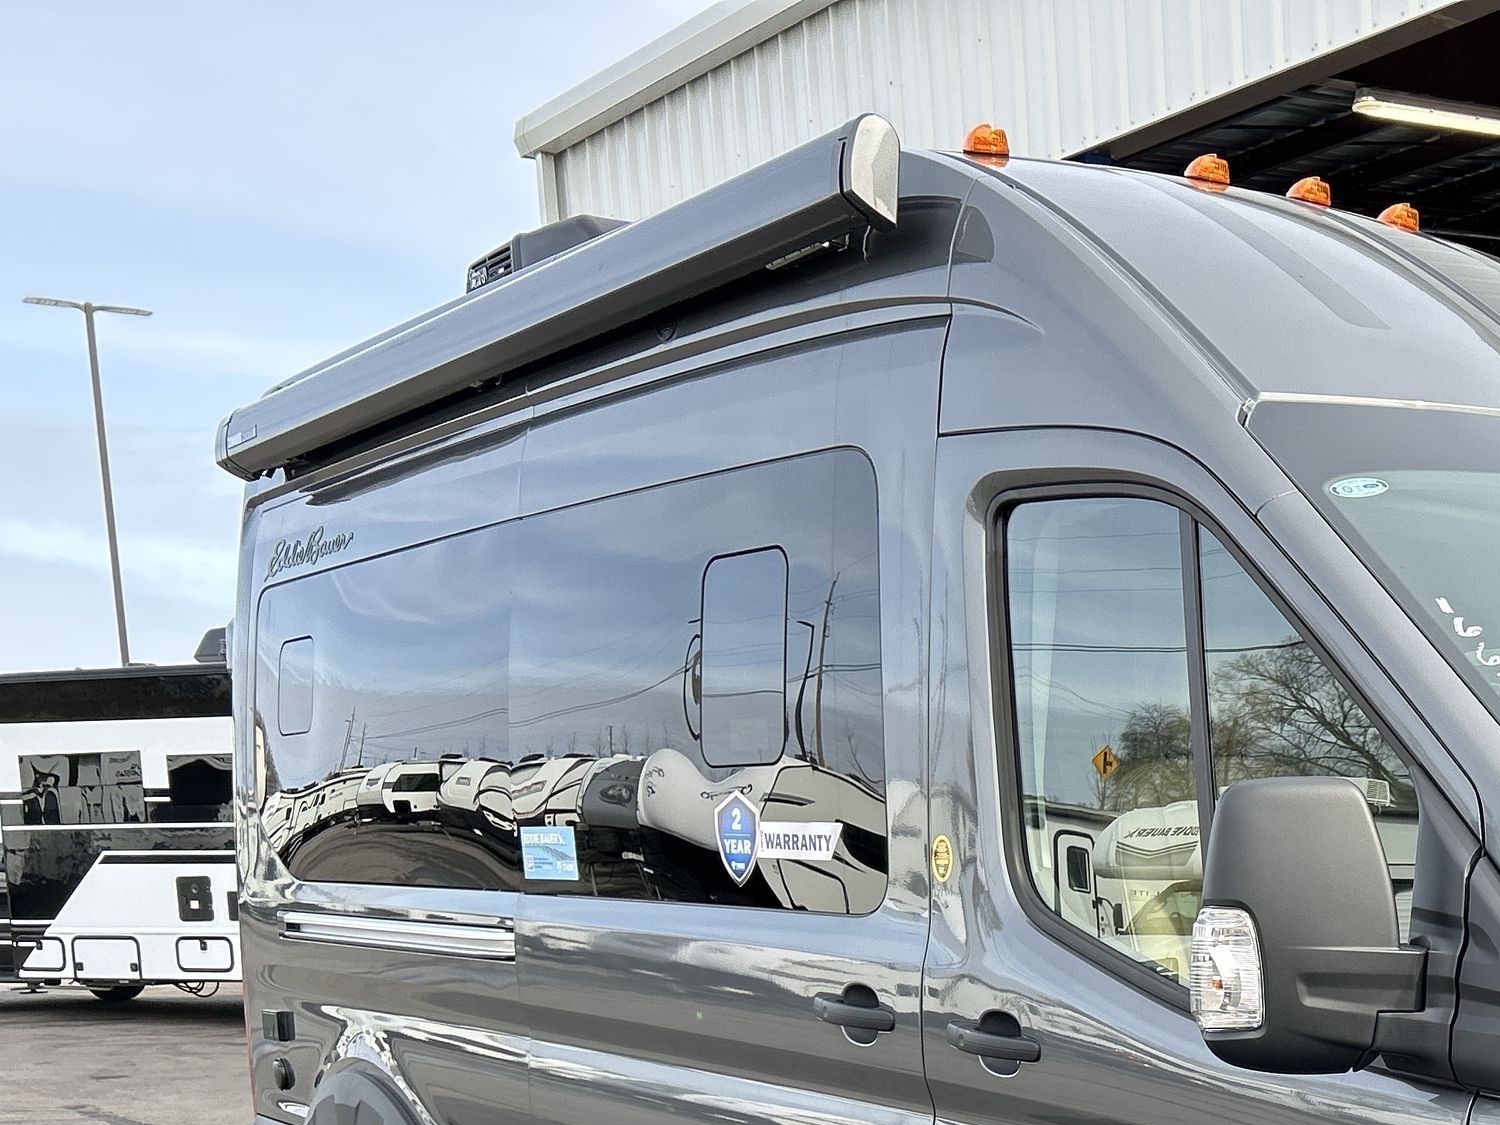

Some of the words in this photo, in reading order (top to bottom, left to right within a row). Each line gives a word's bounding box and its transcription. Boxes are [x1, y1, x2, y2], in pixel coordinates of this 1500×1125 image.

[731, 807, 742, 831] 2
[723, 839, 752, 855] YEAR
[764, 832, 832, 852] WARRANTY
